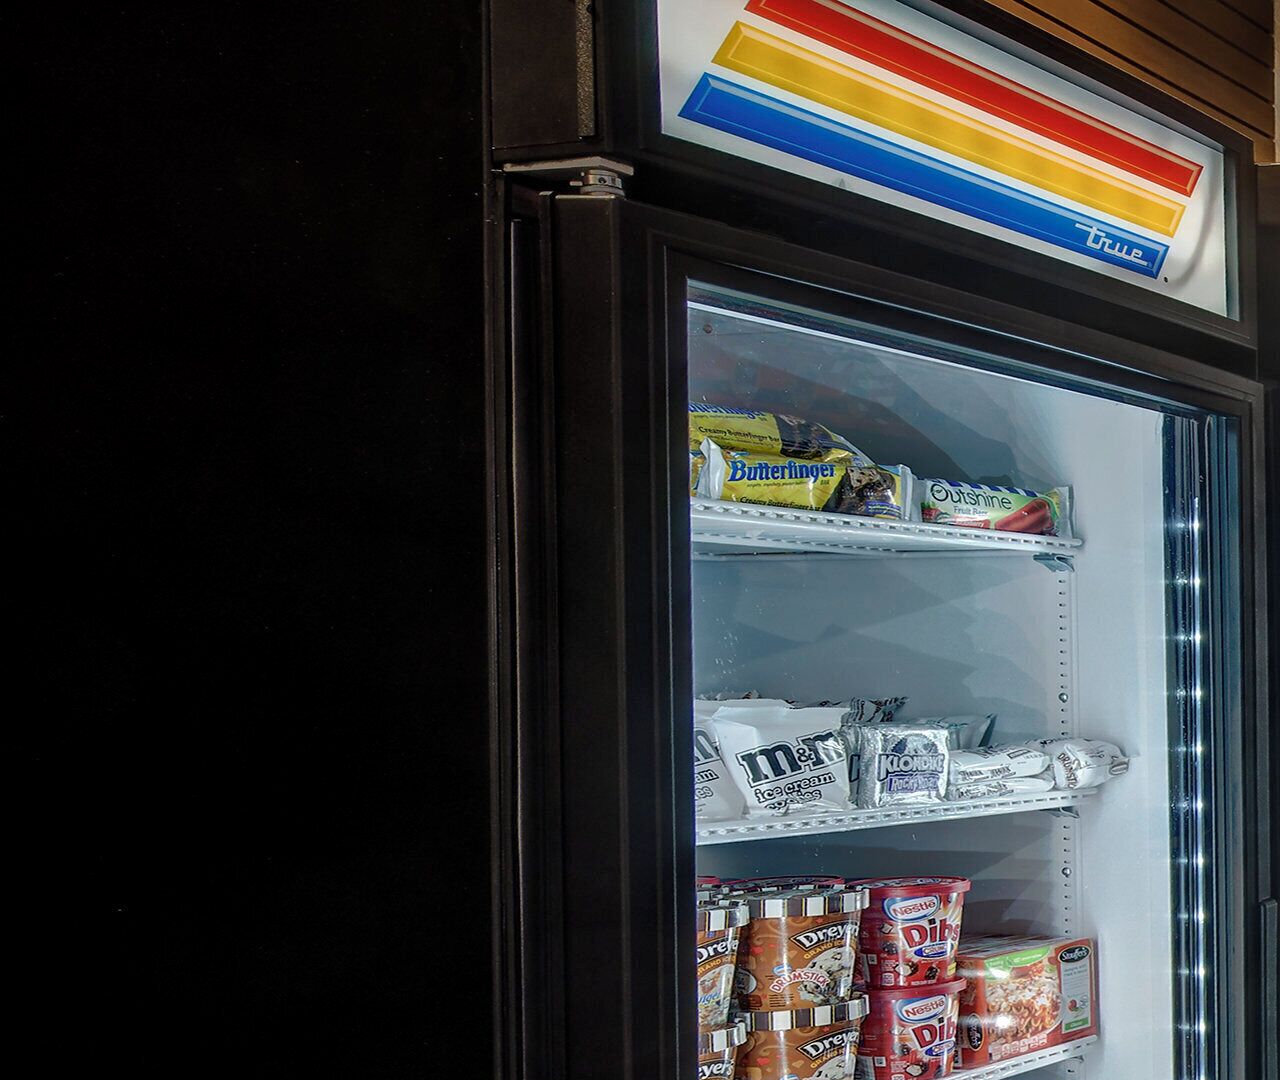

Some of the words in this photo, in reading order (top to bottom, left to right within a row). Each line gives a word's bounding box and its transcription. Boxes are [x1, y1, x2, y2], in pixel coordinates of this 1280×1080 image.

[728, 459, 836, 484] Butterfinger
[930, 483, 1013, 510] Outshine
[902, 918, 960, 949] Dibs
